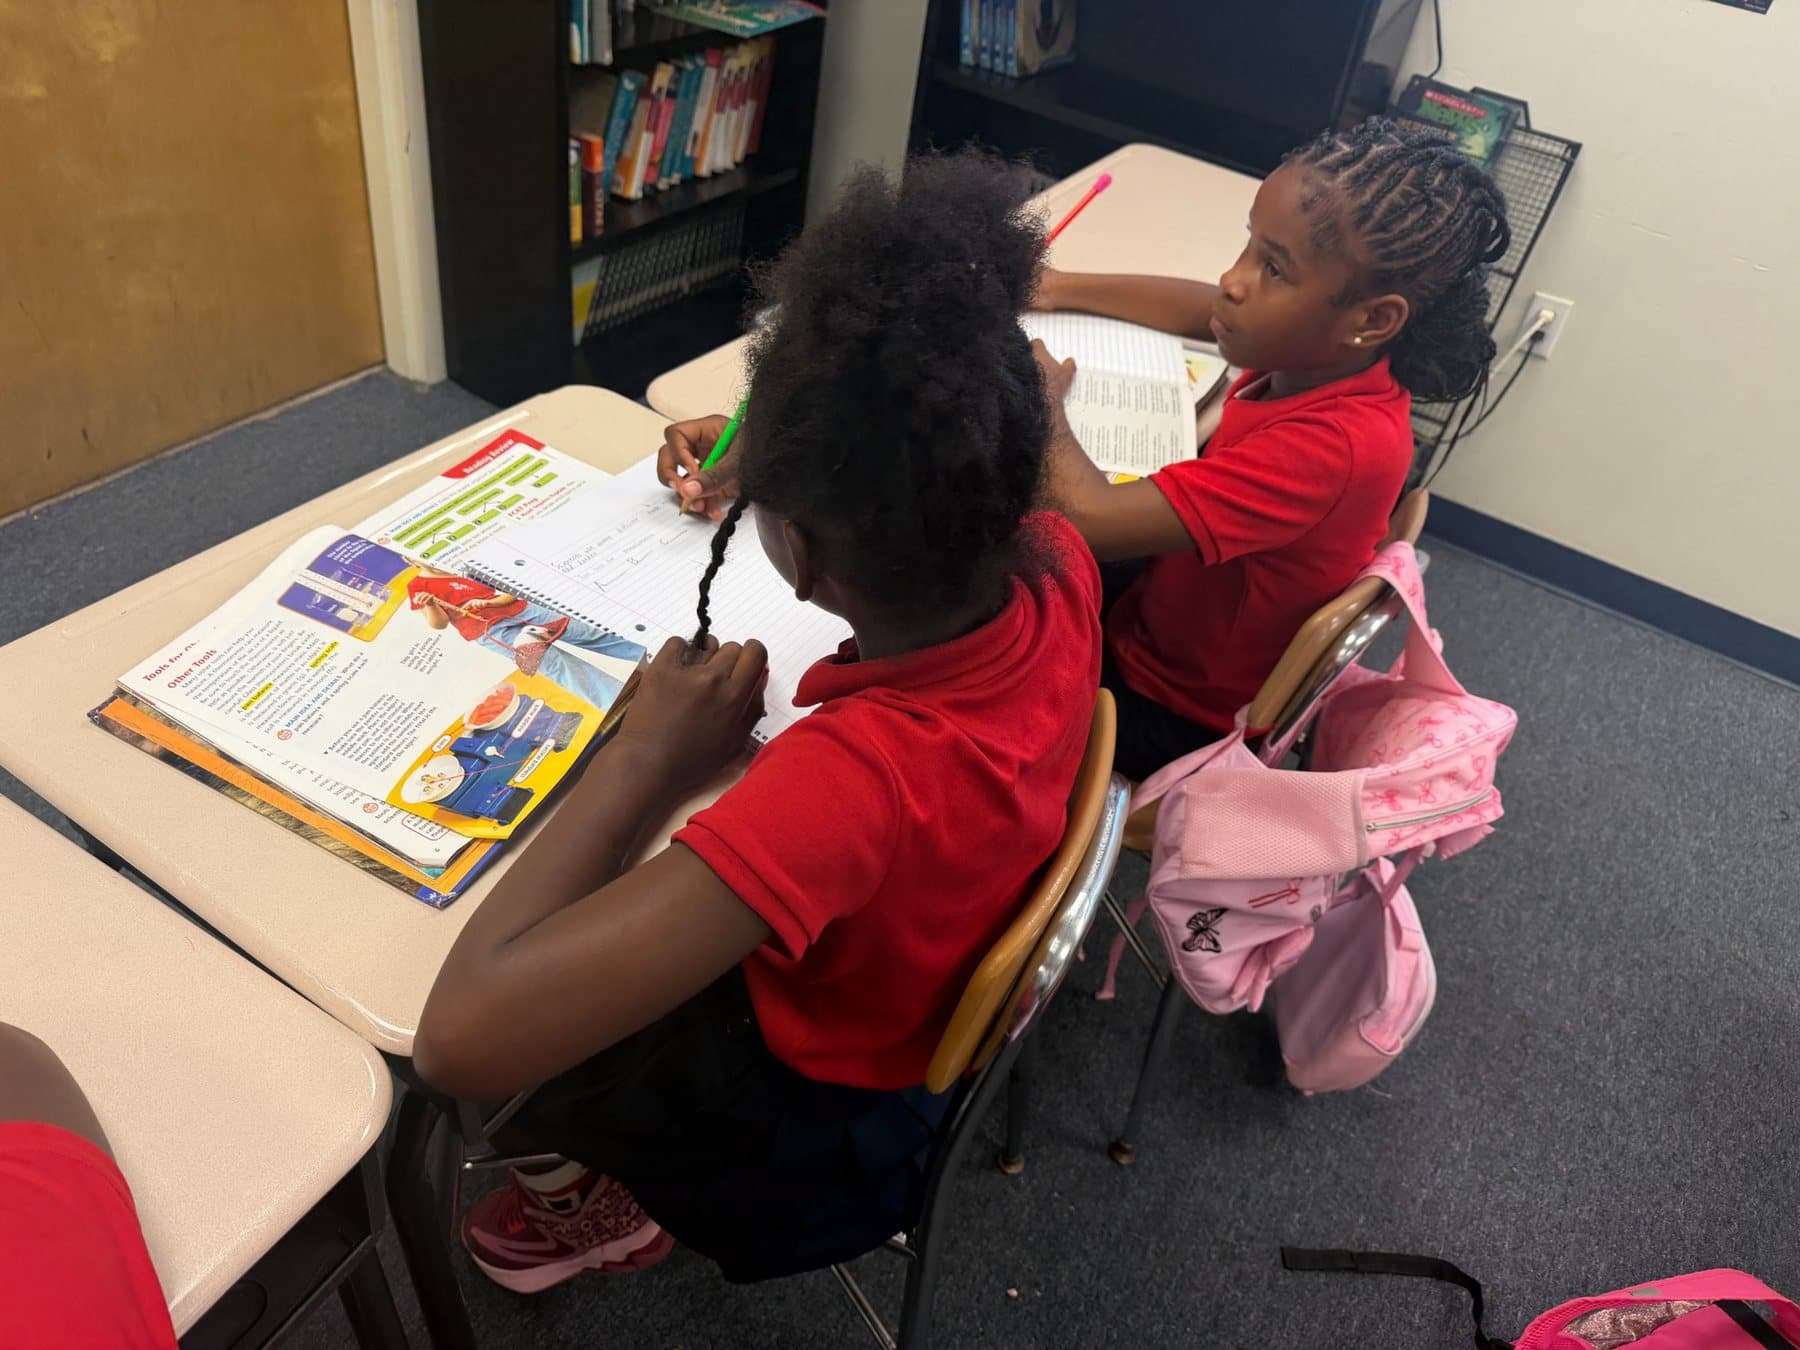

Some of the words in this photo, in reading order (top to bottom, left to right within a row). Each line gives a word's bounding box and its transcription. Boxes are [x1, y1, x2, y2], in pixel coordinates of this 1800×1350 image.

[143, 664, 169, 680] Tools
[168, 668, 193, 688] Other
[192, 650, 216, 666] Tools
[251, 683, 272, 700] balance
